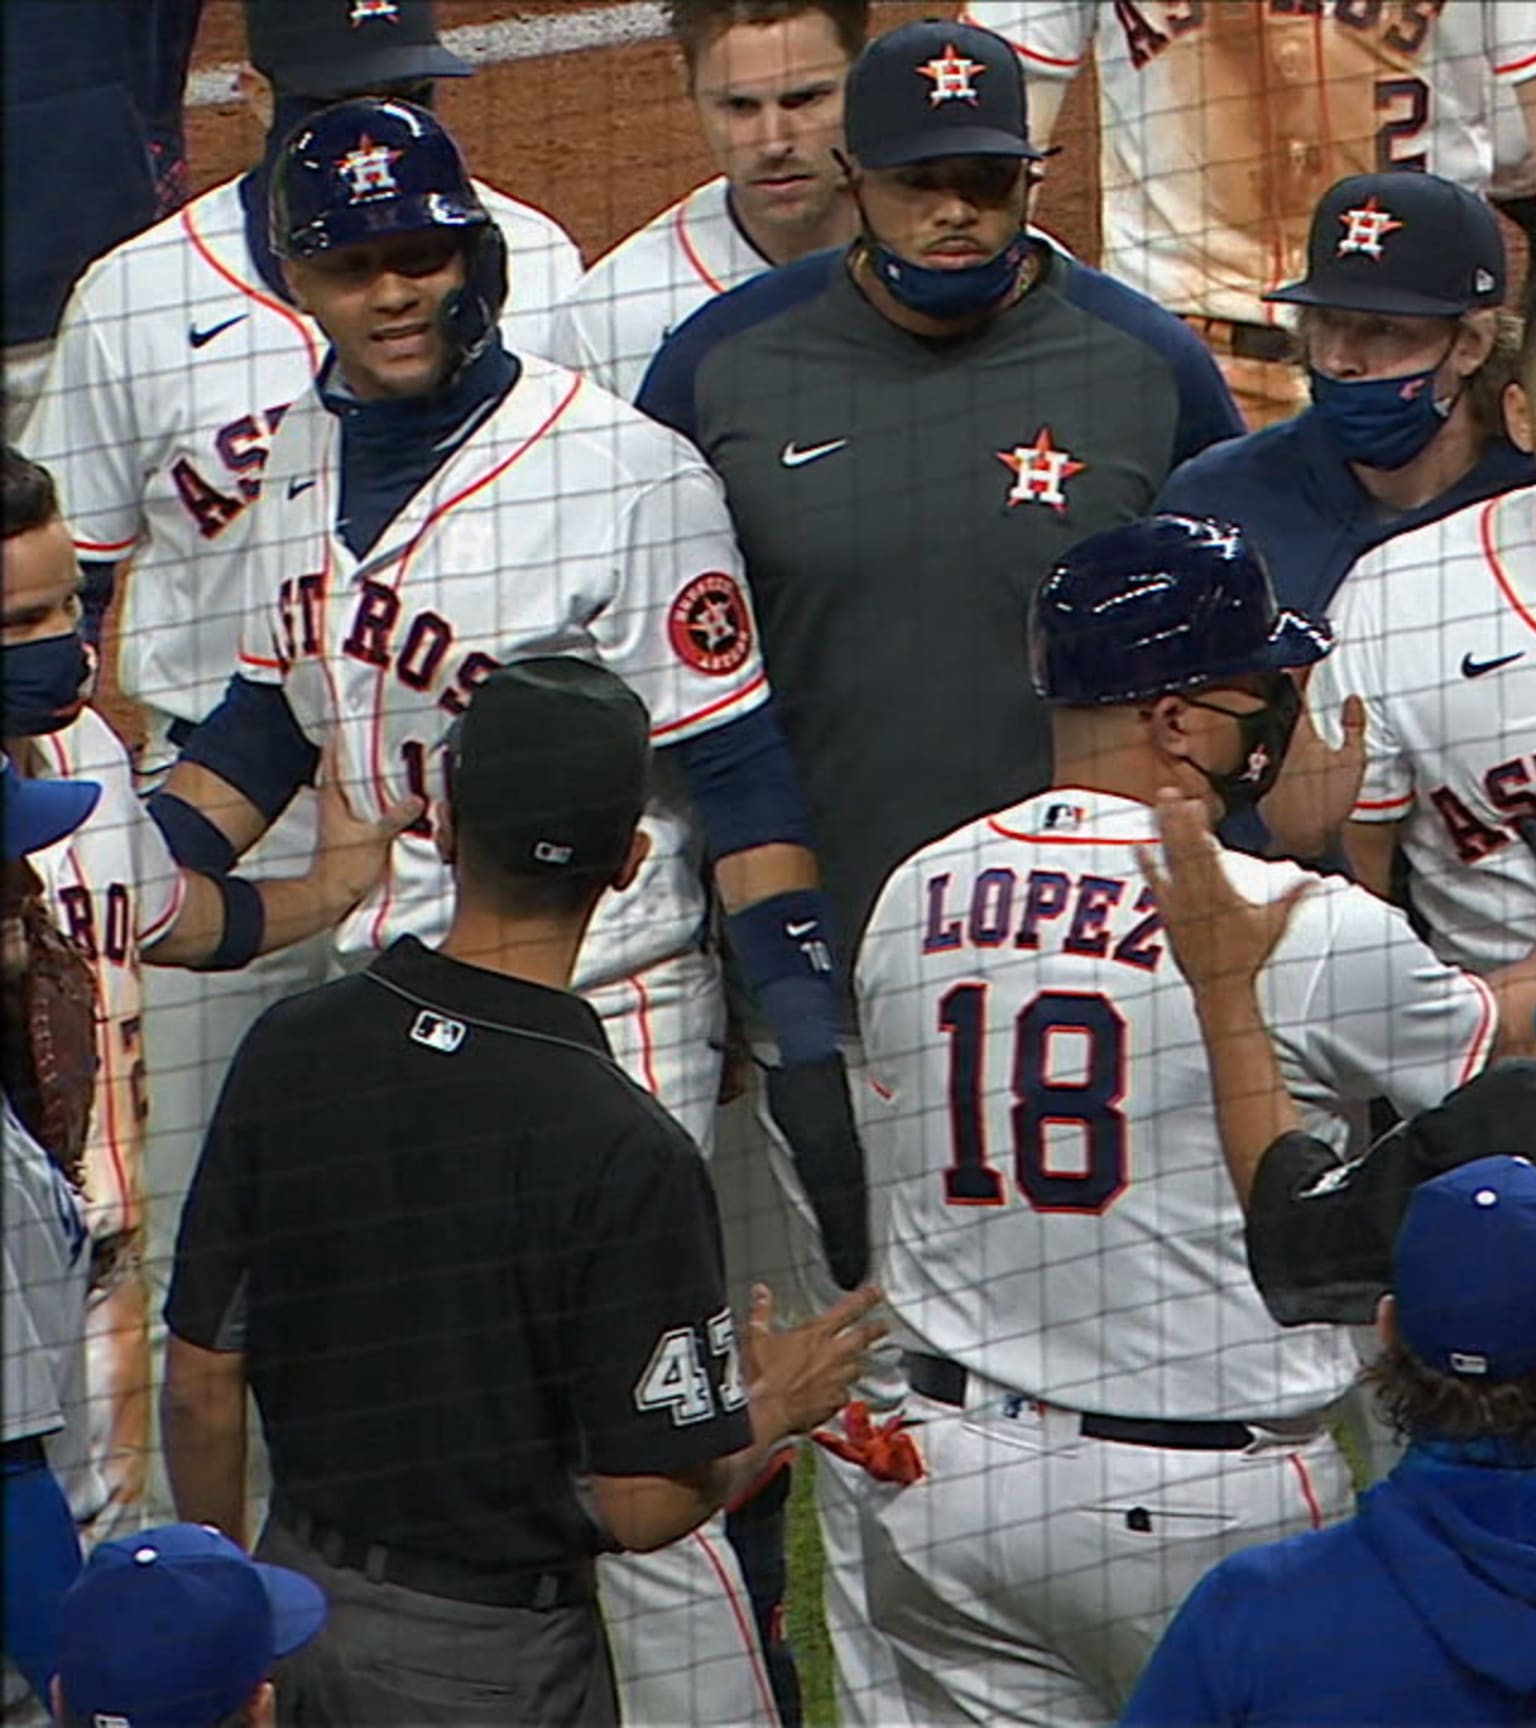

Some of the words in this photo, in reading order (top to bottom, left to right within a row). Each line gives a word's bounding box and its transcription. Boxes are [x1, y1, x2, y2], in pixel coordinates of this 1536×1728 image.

[928, 59, 976, 100] H
[1374, 77, 1430, 173] 2
[1339, 211, 1390, 254] H
[171, 402, 294, 541] AS
[1008, 447, 1069, 502] H
[401, 738, 458, 852] 1
[923, 867, 1166, 975] LOPEZ
[938, 982, 1130, 1215] 18
[633, 1306, 750, 1427] 47
